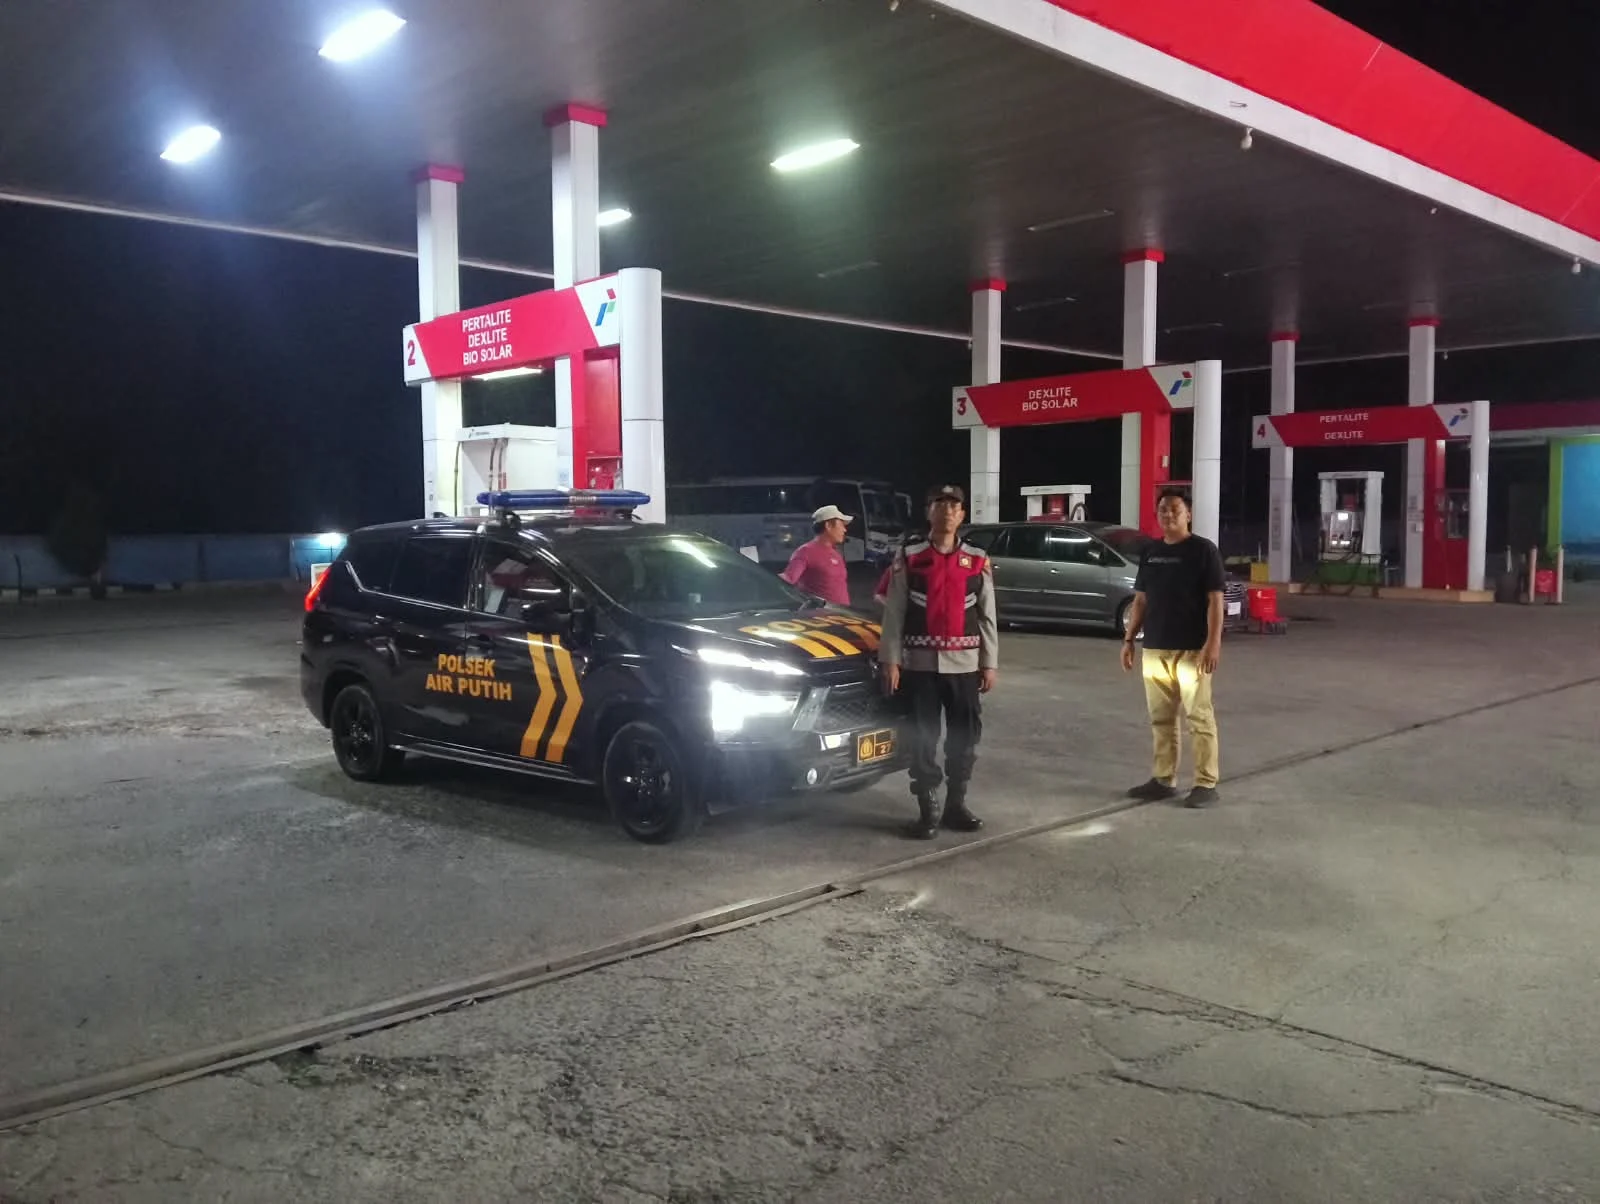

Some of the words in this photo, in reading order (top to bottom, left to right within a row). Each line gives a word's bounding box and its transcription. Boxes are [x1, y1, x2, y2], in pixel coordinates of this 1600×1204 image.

[462, 309, 511, 332] PERTALITE
[468, 328, 508, 348] DEXLITE
[407, 339, 416, 366] 2
[463, 350, 479, 365] BIO
[480, 344, 513, 362] SOLAR
[1028, 387, 1071, 399] DEXLITE
[956, 397, 967, 416] 3
[1022, 401, 1039, 411] BIO
[1041, 397, 1078, 410] SOLAR
[1319, 412, 1369, 423] PERTALITE
[1257, 424, 1266, 438] 4
[1324, 430, 1364, 440] DEXLITE
[438, 654, 496, 677] POLSEK
[425, 673, 453, 693] AIR
[458, 678, 512, 700] PUTIH
